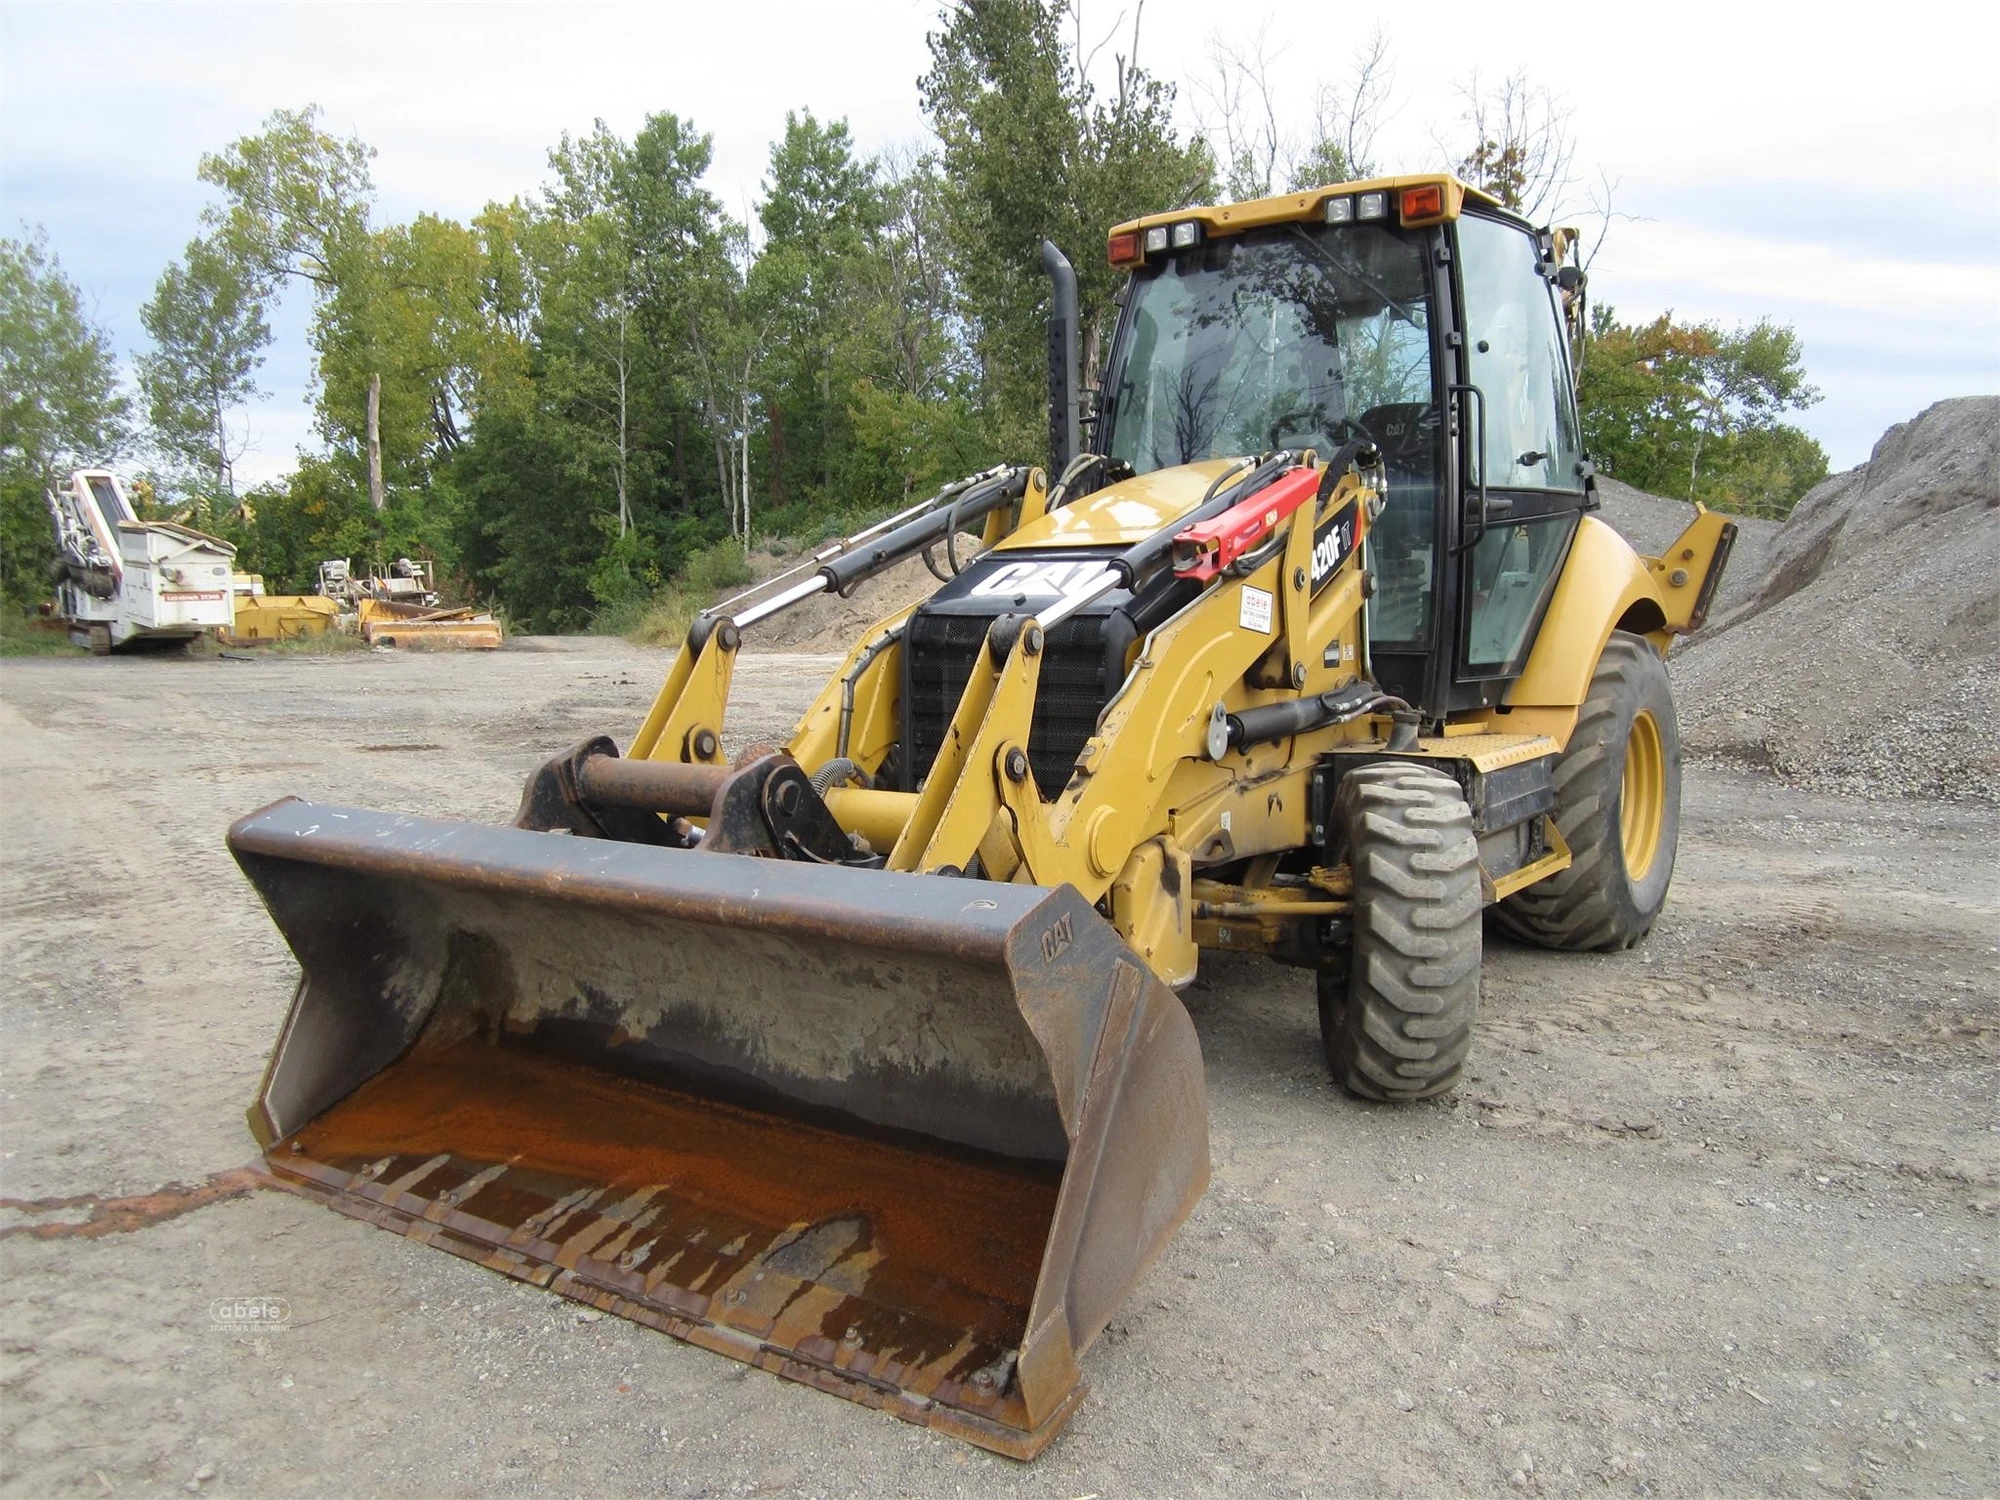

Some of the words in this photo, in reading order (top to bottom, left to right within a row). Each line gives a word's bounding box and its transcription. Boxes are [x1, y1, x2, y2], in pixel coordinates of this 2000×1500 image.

[1386, 423, 1406, 436] CAT
[1311, 524, 1341, 581] 420F
[1041, 911, 1074, 963] CAT
